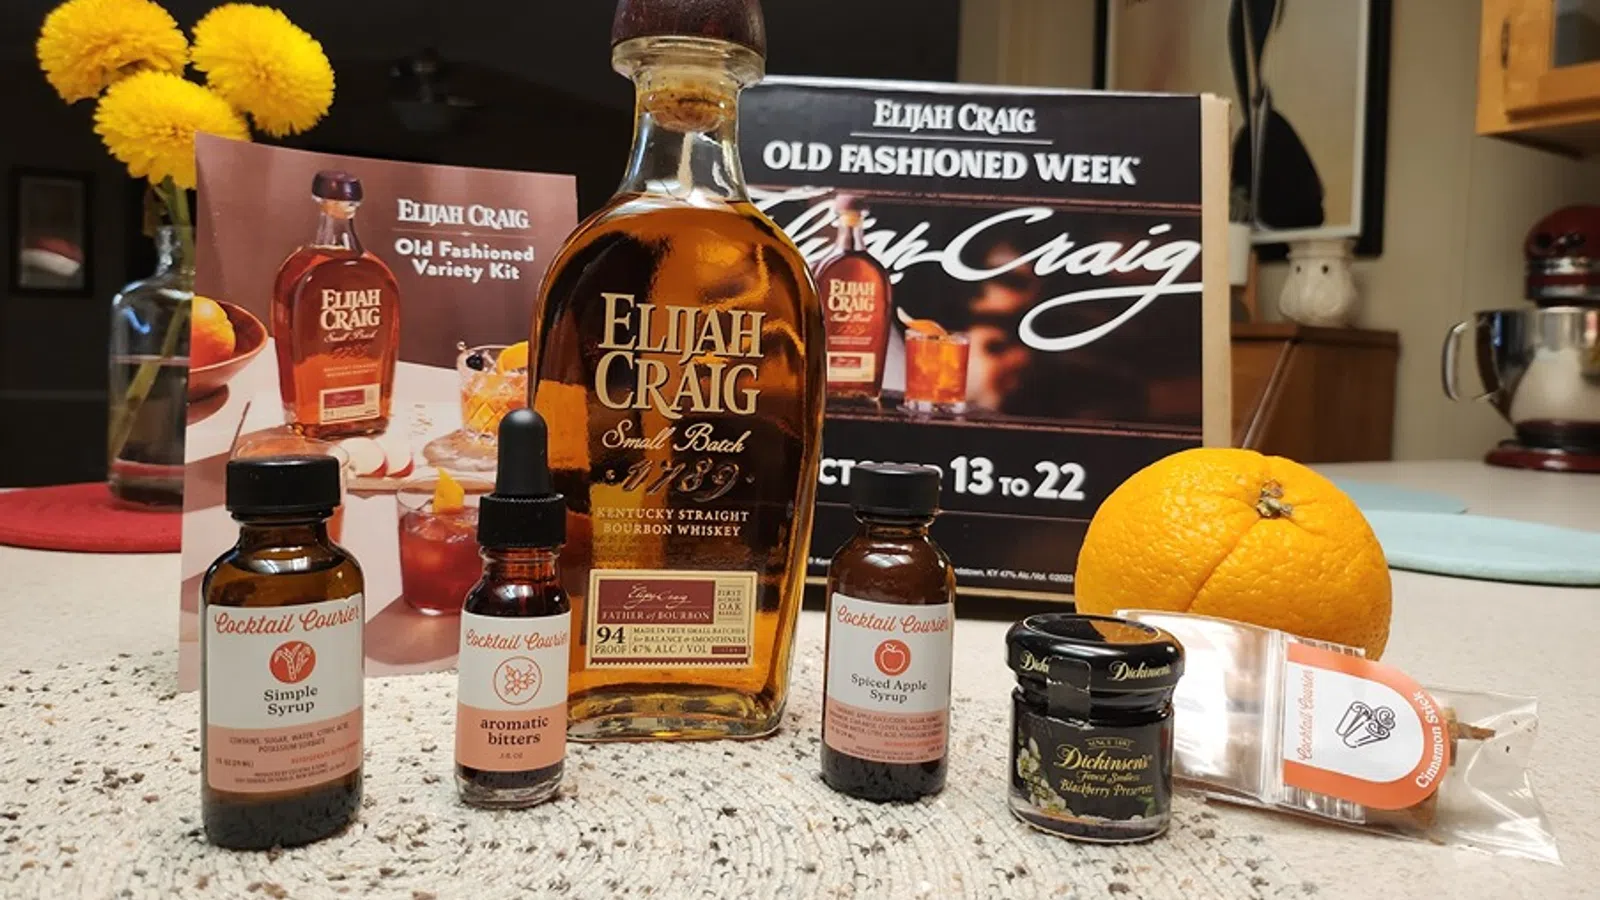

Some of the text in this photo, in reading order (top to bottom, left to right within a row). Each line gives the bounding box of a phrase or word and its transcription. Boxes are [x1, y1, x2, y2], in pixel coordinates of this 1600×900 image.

[873, 98, 1036, 136] ELIJAH CRAIG
[763, 141, 832, 172] OLD
[839, 144, 1028, 181] FASHIONED
[397, 198, 530, 230] ELIJAH CRAIG
[395, 238, 534, 262] Old Fashioned
[412, 258, 520, 284] Variety Kit
[941, 207, 1203, 351] Craig
[829, 279, 876, 297] ELIJAH
[321, 289, 381, 311] ELIJAH
[828, 295, 875, 314] CRAIG
[320, 308, 381, 331] CRAIG
[598, 292, 767, 365] ELIJAH
[595, 351, 761, 420] CRAIG
[602, 419, 752, 453] Small Batch
[950, 456, 995, 496] 13
[998, 477, 1031, 498] TO
[1034, 461, 1086, 501] 22
[596, 506, 750, 522] KENTUCKY STRAIGHT
[603, 522, 742, 537] BOURBON WHISKEY
[602, 611, 644, 621] FATHER
[646, 612, 657, 621] of
[658, 611, 710, 621] BOURBON
[718, 602, 743, 611] OAK
[214, 604, 360, 635] Cocktail Courier
[837, 604, 897, 632] Cocktail
[466, 628, 521, 651] Cocktail
[596, 626, 625, 645] 94
[633, 627, 657, 635] MADE
[691, 636, 746, 644] SMOOTHNESS
[594, 645, 627, 655] PROOF
[632, 645, 653, 654] 47%
[654, 645, 677, 654] ALC
[687, 645, 708, 654] VOL
[851, 673, 928, 693] Spiced Apple
[263, 685, 319, 703] Simple
[870, 689, 908, 704] Syrup
[267, 701, 315, 717] Syrup
[480, 716, 549, 731] aromatic
[488, 732, 541, 746] bitters
[1413, 691, 1444, 788] Cinnamon Stick
[1060, 778, 1154, 798] Blackberry Preserves
